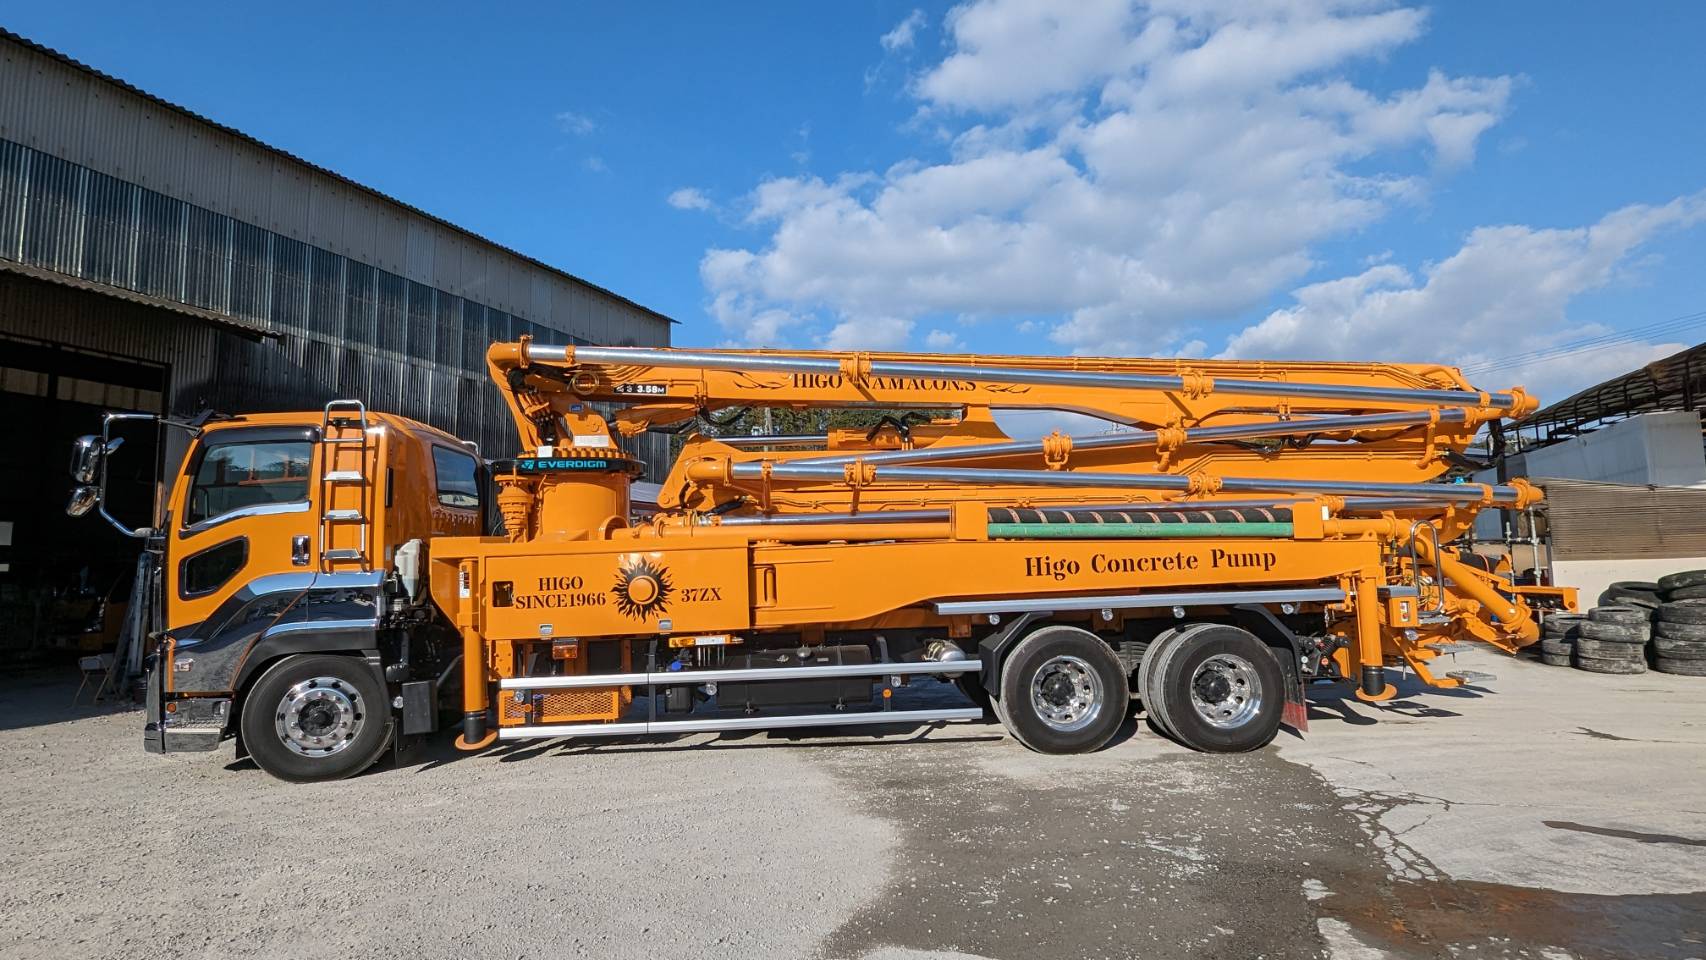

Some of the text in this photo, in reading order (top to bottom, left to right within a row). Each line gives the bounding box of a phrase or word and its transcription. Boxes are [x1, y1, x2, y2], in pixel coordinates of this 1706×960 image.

[792, 373, 843, 389] HIGO
[538, 460, 607, 469] EVERDIGM
[1025, 548, 1277, 581] Higo Concrete Pump
[538, 576, 584, 592] HIGO
[515, 592, 607, 610] SINCE1966
[681, 587, 723, 603] 37ZX
